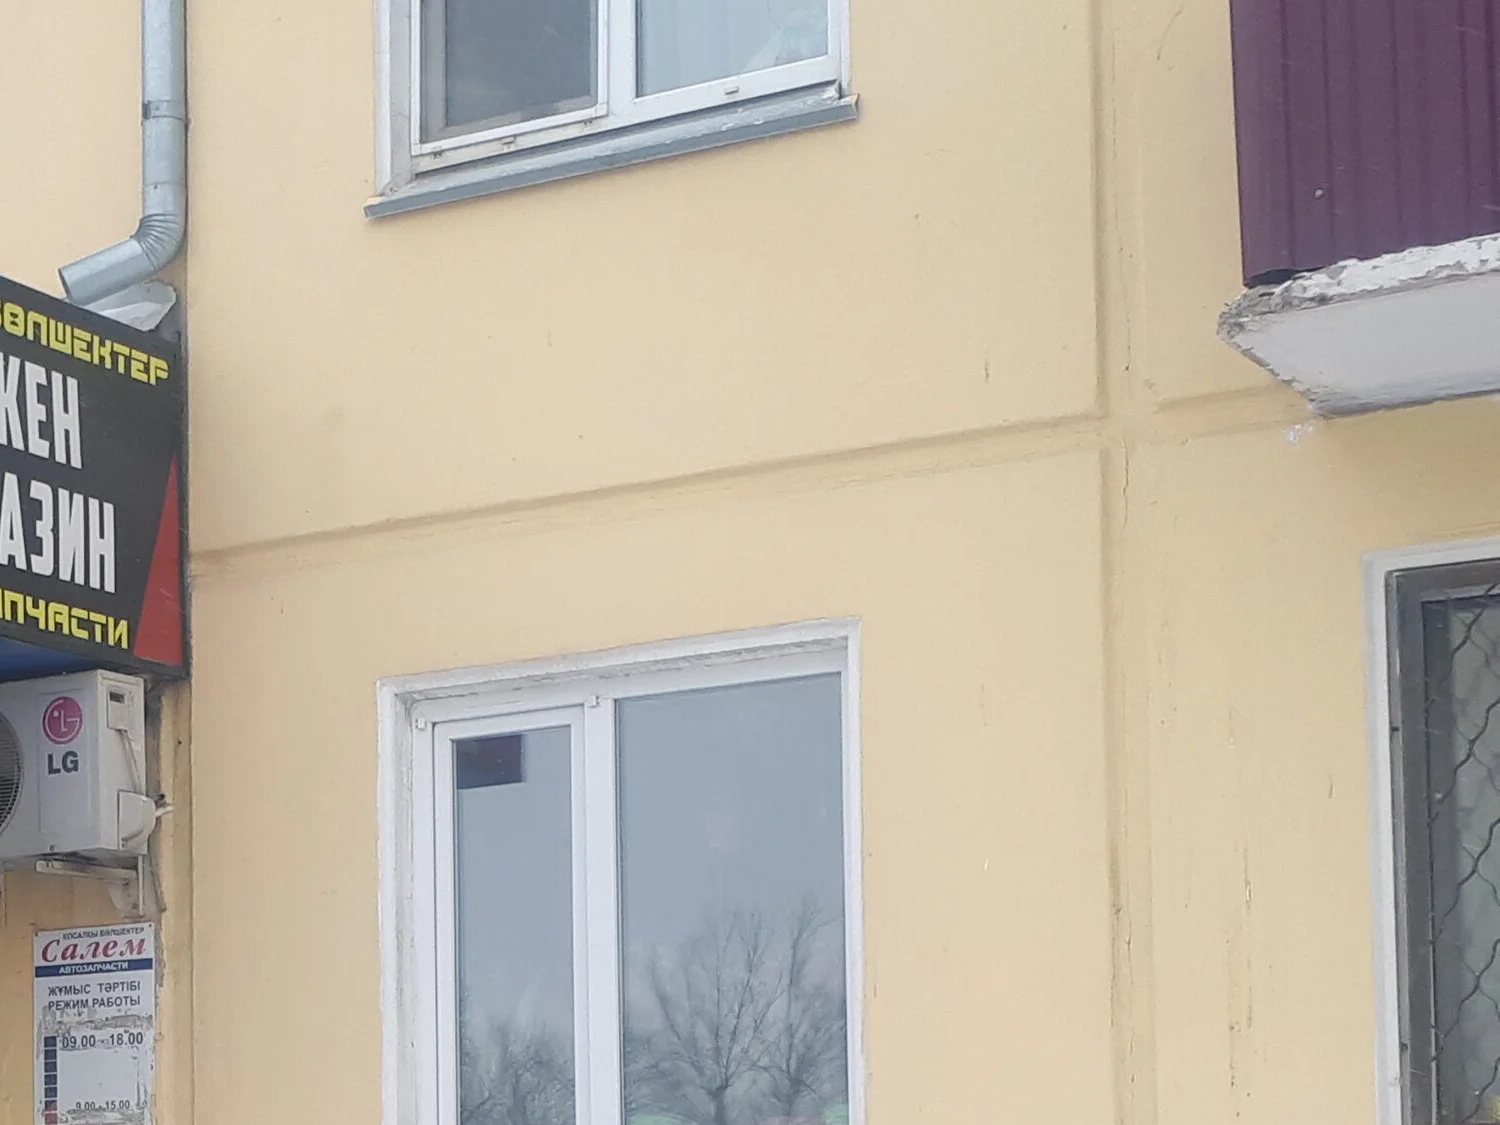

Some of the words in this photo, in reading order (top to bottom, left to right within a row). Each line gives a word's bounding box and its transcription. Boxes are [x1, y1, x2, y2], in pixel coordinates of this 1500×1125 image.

[47, 751, 79, 774] LG
[41, 938, 147, 963] Салем
[59, 961, 129, 975] АВТОЗАПЧАСТИ
[98, 980, 141, 993] ТӘРТІБІ
[48, 998, 89, 1011] РЕЖИМ
[92, 995, 140, 1009] РАБОТЫ
[110, 1032, 144, 1046] 18.00
